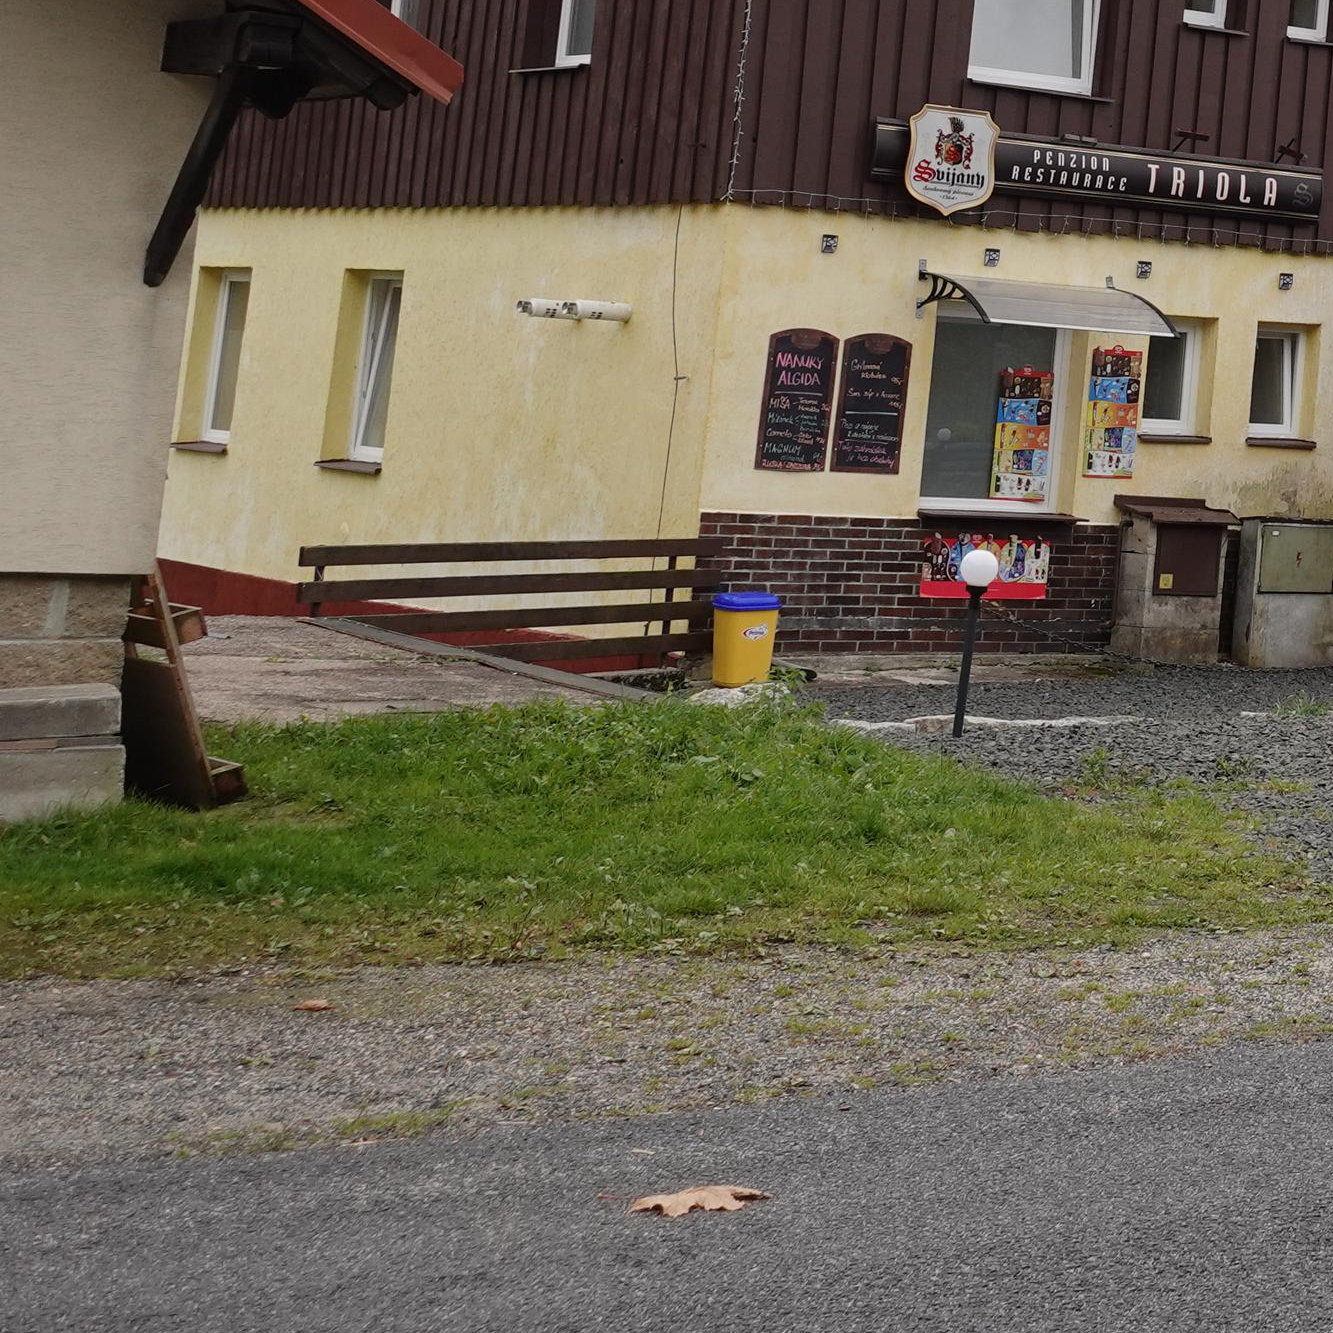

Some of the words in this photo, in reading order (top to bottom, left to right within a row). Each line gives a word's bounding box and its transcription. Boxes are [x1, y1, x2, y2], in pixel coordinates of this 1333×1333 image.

[1033, 149, 1110, 172] PENZION
[912, 158, 985, 190] Svijany
[1011, 165, 1128, 192] RESTAURACE
[1147, 163, 1278, 207] TRIOLA
[775, 351, 825, 370] NANUKY
[777, 370, 821, 386] ALGIDA
